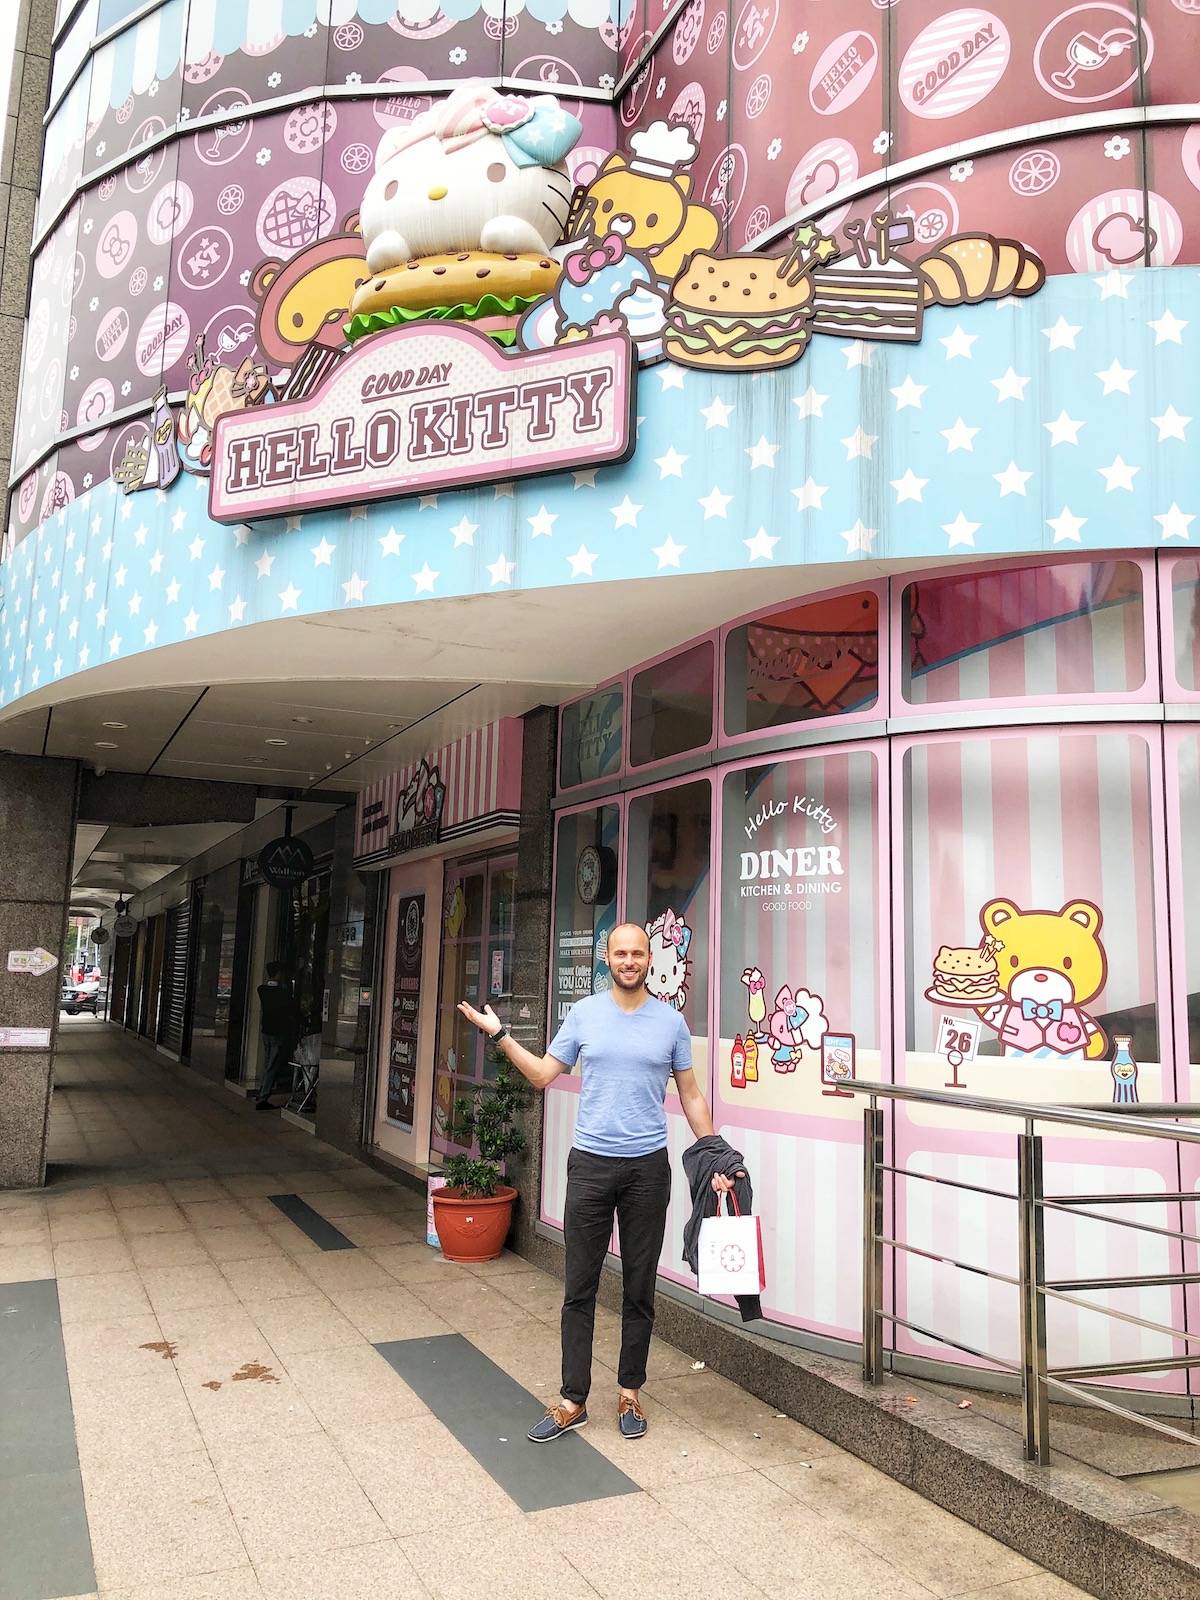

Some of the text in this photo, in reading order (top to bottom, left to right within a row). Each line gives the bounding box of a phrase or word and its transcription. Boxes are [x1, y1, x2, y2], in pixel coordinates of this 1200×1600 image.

[820, 46, 858, 92] HELLO
[912, 22, 995, 102] GOOD DAY
[825, 54, 864, 101] KITTY
[384, 103, 418, 120] KITTY
[388, 97, 421, 108] HELLO
[101, 317, 122, 343] HELLO
[104, 325, 124, 352] KITTY
[140, 314, 184, 364] GOOD DAY
[361, 362, 453, 397] GOOD DAY
[225, 366, 614, 494] HELLO KITTY
[744, 795, 838, 840] Hello Kitty
[739, 845, 845, 880] DINER
[740, 881, 842, 897] KITCHEN & DINING
[762, 901, 812, 911] GOOD FOOD
[558, 967, 574, 976] THANK
[558, 976, 592, 989] YOU LOVE
[402, 997, 414, 1011] Pasta
[557, 1001, 575, 1020] LAT
[943, 1016, 955, 1027] No.
[945, 1029, 972, 1053] 26
